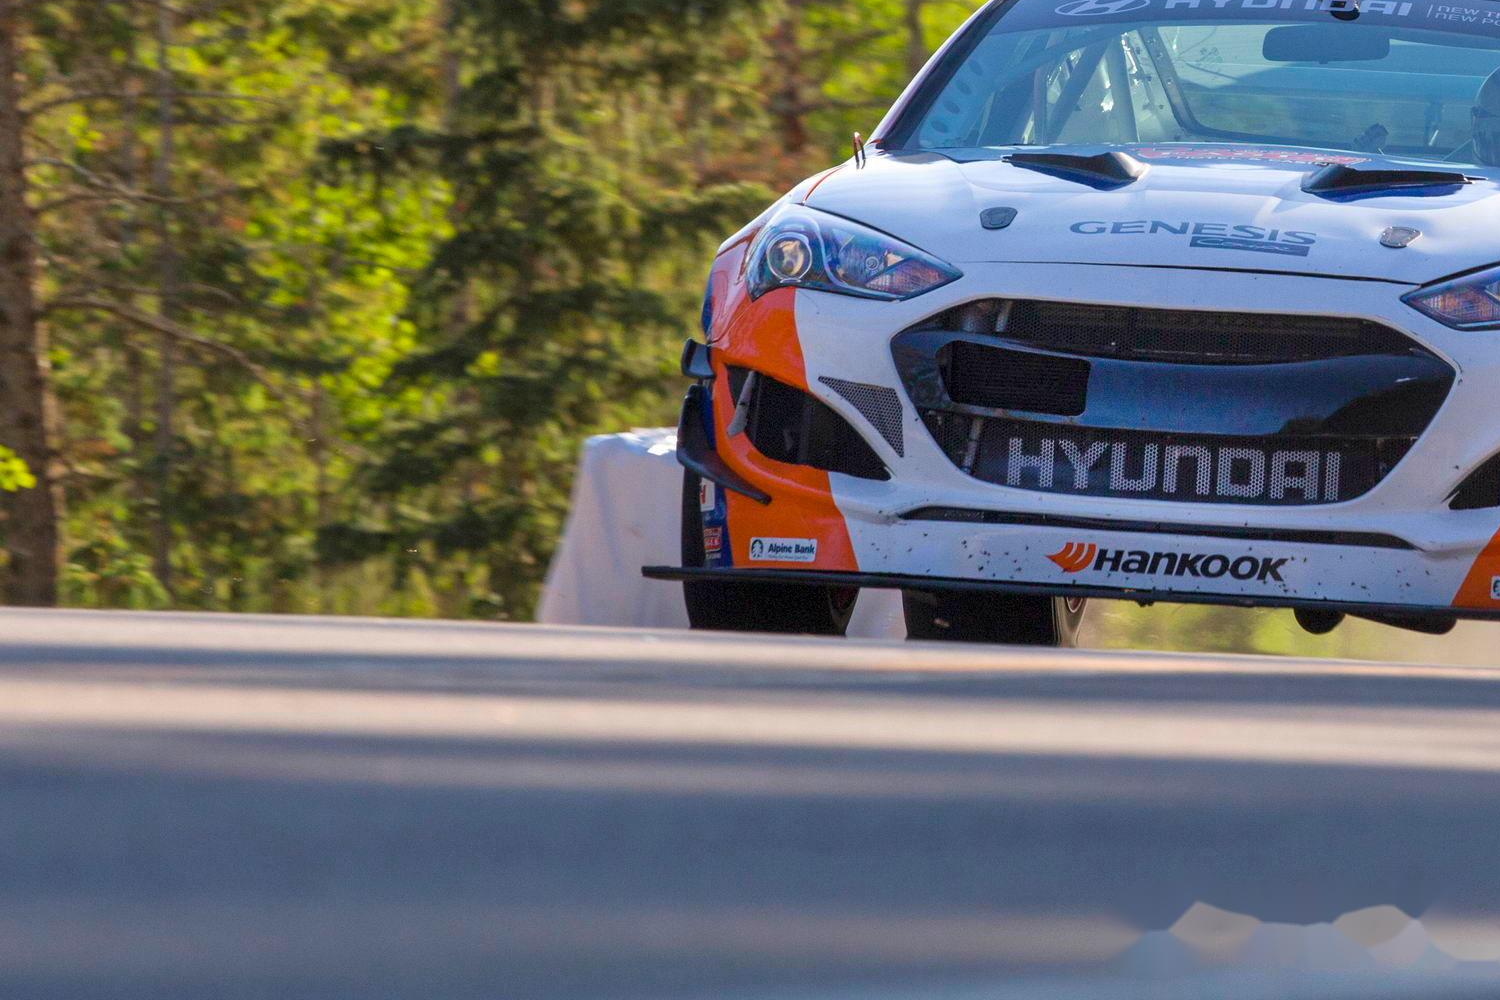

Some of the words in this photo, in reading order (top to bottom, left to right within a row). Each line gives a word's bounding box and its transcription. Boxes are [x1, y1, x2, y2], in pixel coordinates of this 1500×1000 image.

[1438, 5, 1480, 16] NEW
[1434, 12, 1477, 23] NEW
[1069, 220, 1317, 245] GENESIS
[1006, 438, 1342, 501] HYUNDAI
[768, 543, 793, 554] Alpine
[795, 544, 815, 554] Bank
